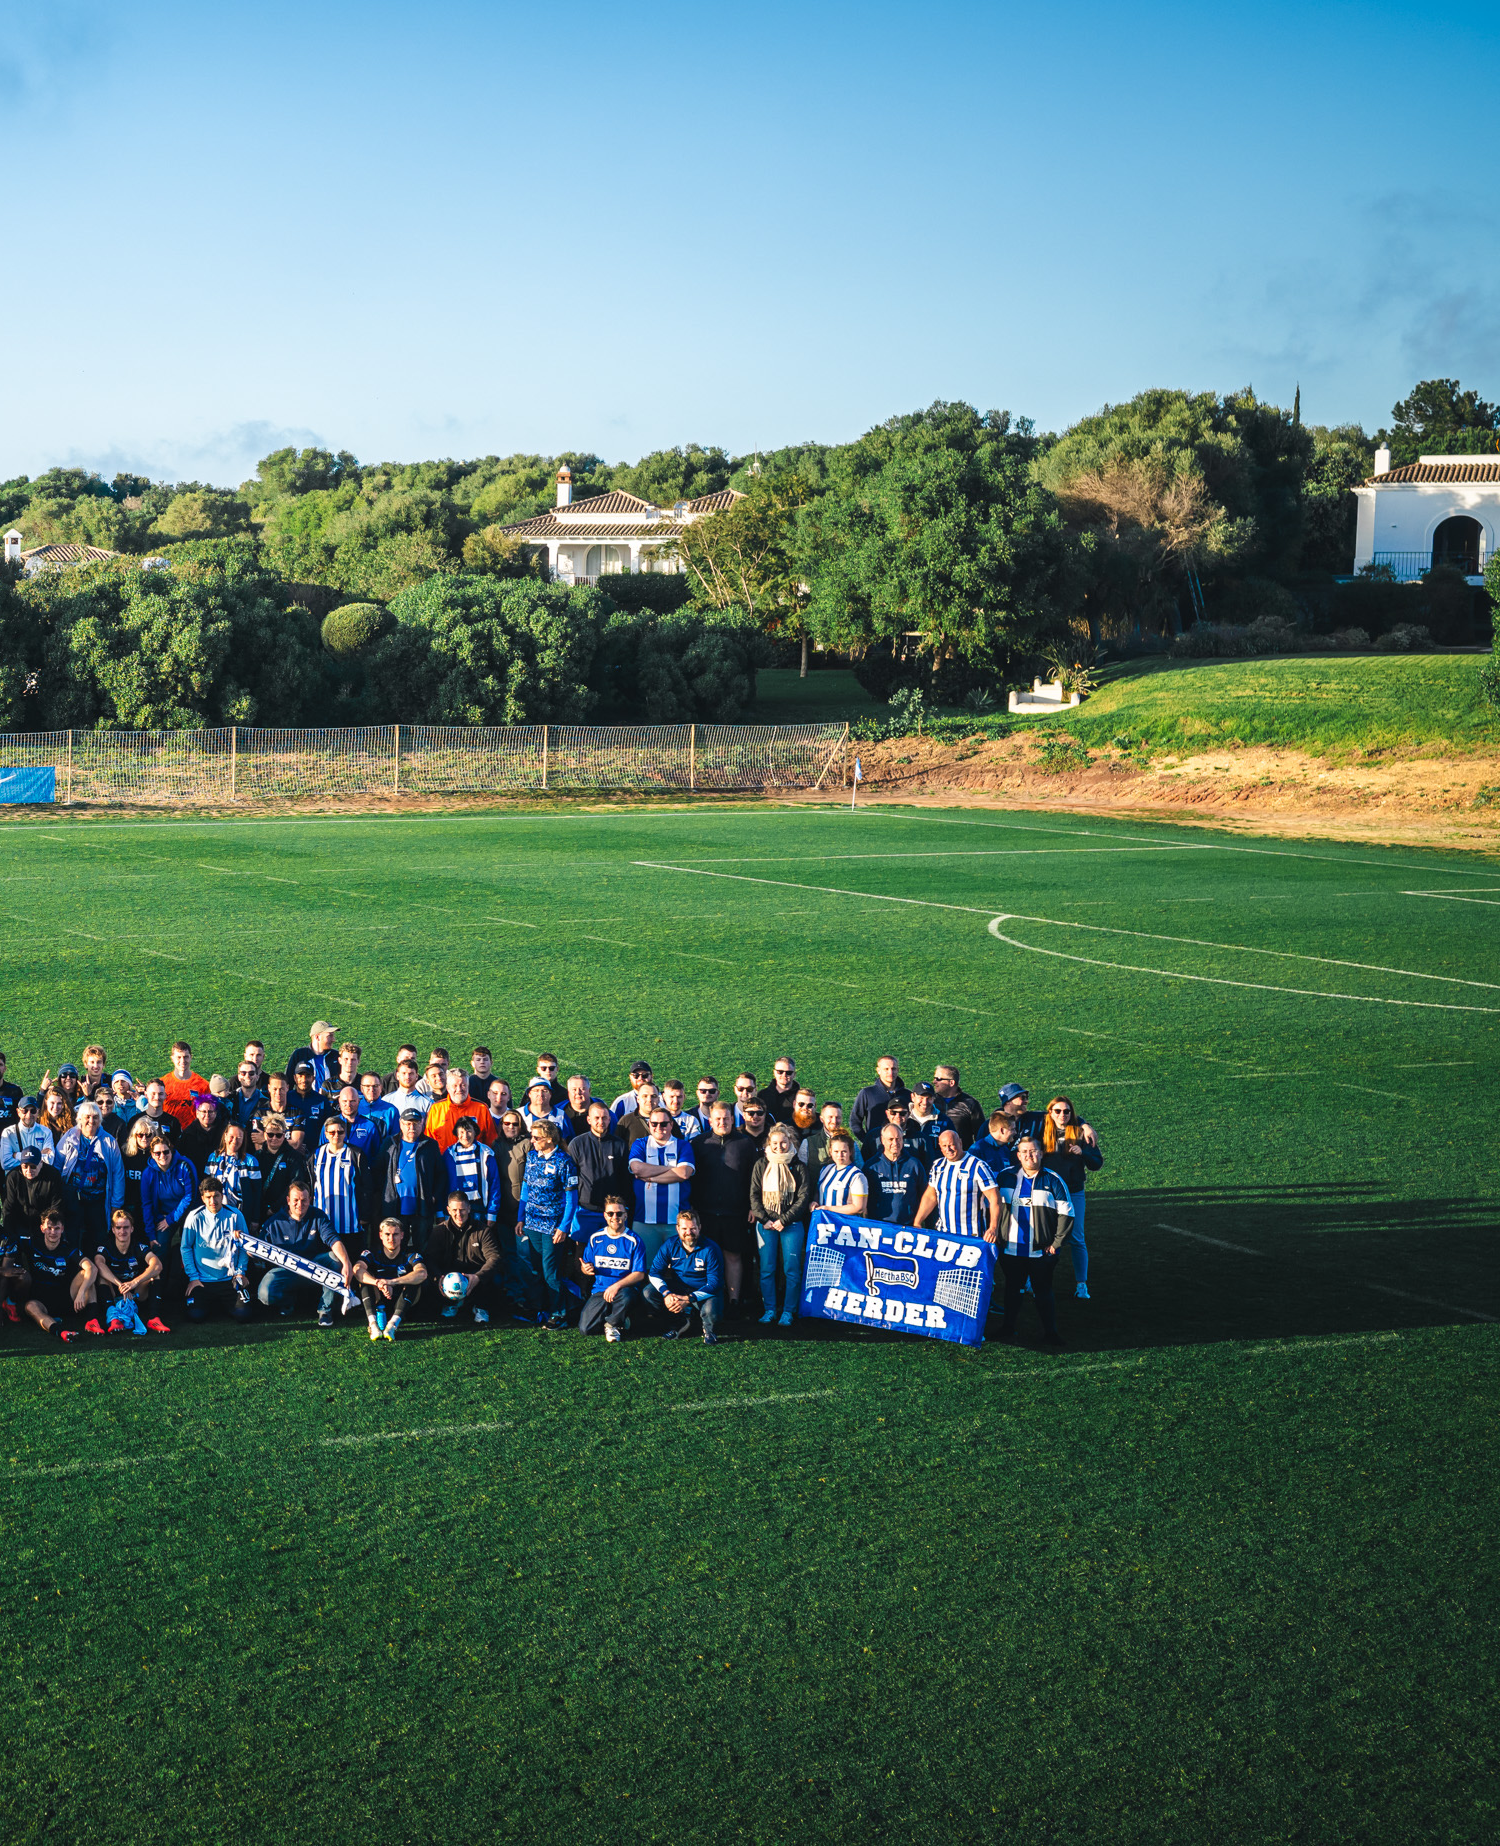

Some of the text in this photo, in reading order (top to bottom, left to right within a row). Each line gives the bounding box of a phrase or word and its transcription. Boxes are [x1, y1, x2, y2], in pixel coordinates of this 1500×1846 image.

[125, 1169, 142, 1180] ER
[816, 1223, 982, 1268] FAN-CLUB
[307, 1263, 342, 1289] '98
[875, 1269, 914, 1283] Hertha BSC
[824, 1287, 947, 1329] HERDER
